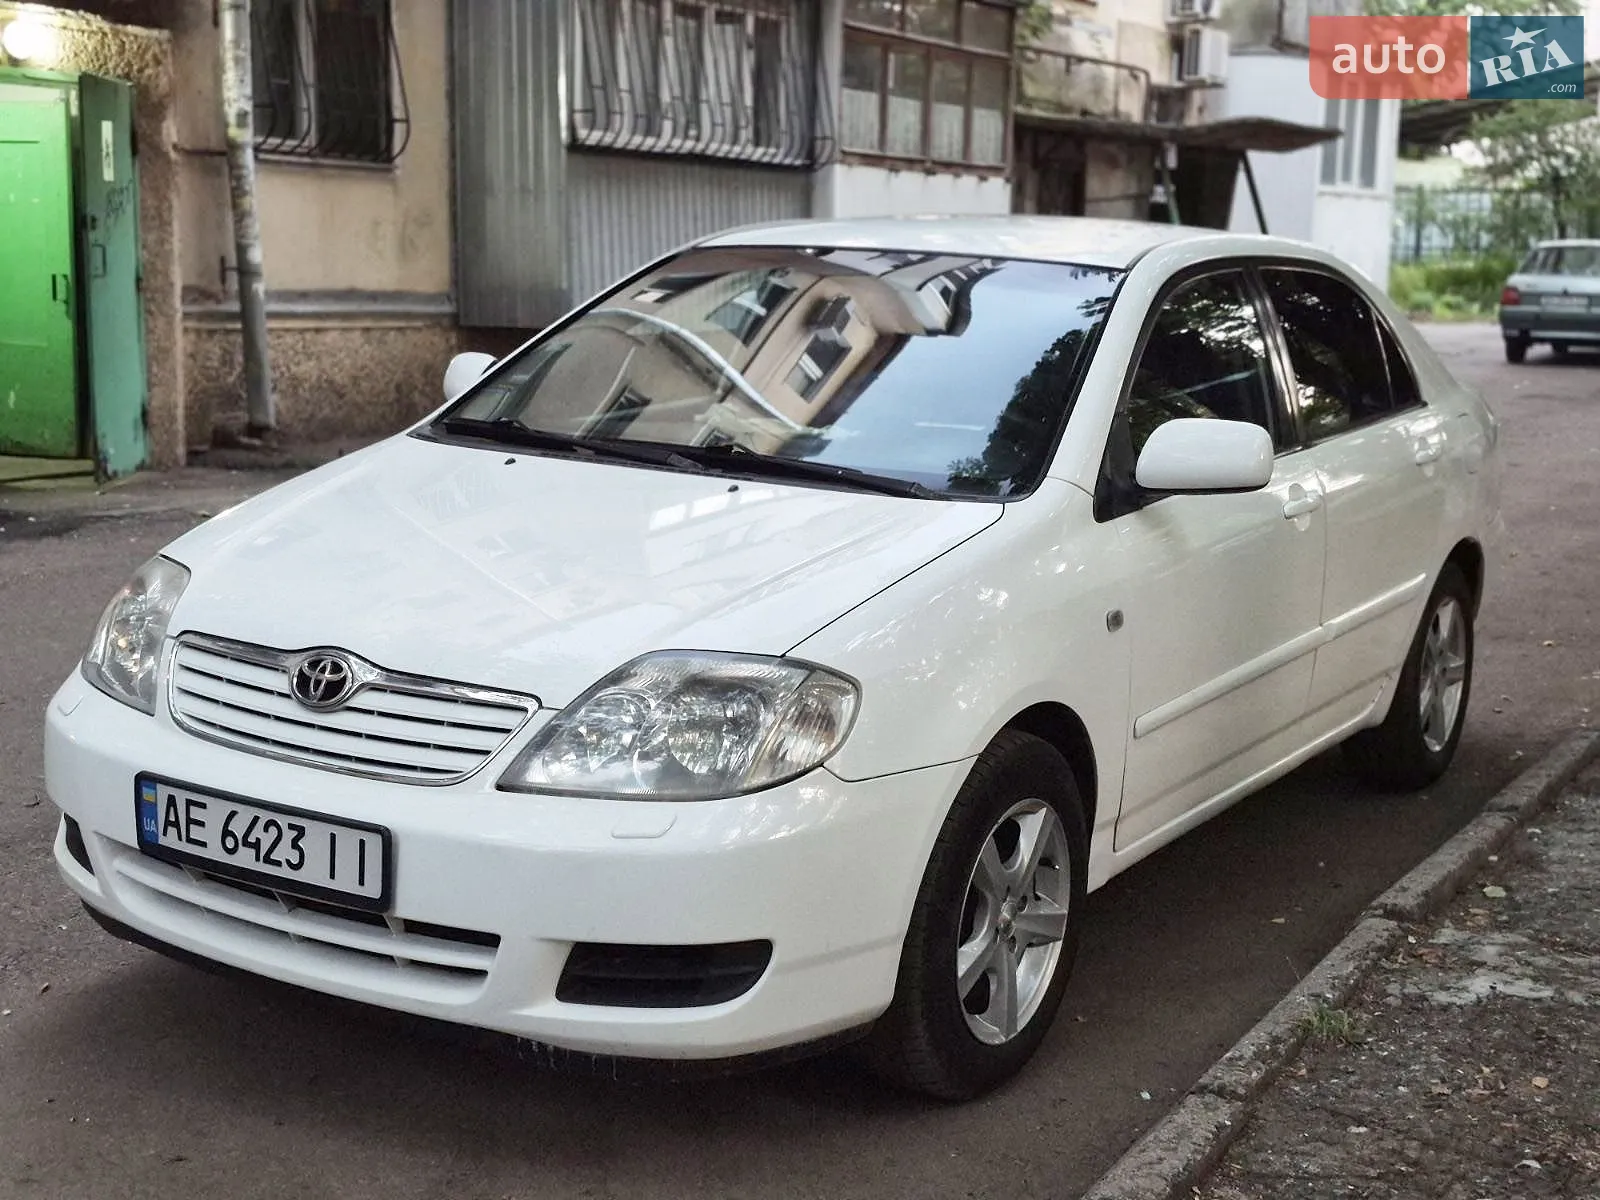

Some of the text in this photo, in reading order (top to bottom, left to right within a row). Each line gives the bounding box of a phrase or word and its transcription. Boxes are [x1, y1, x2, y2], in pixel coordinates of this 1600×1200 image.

[143, 817, 157, 832] UA
[163, 794, 366, 887] AE 6423 II
